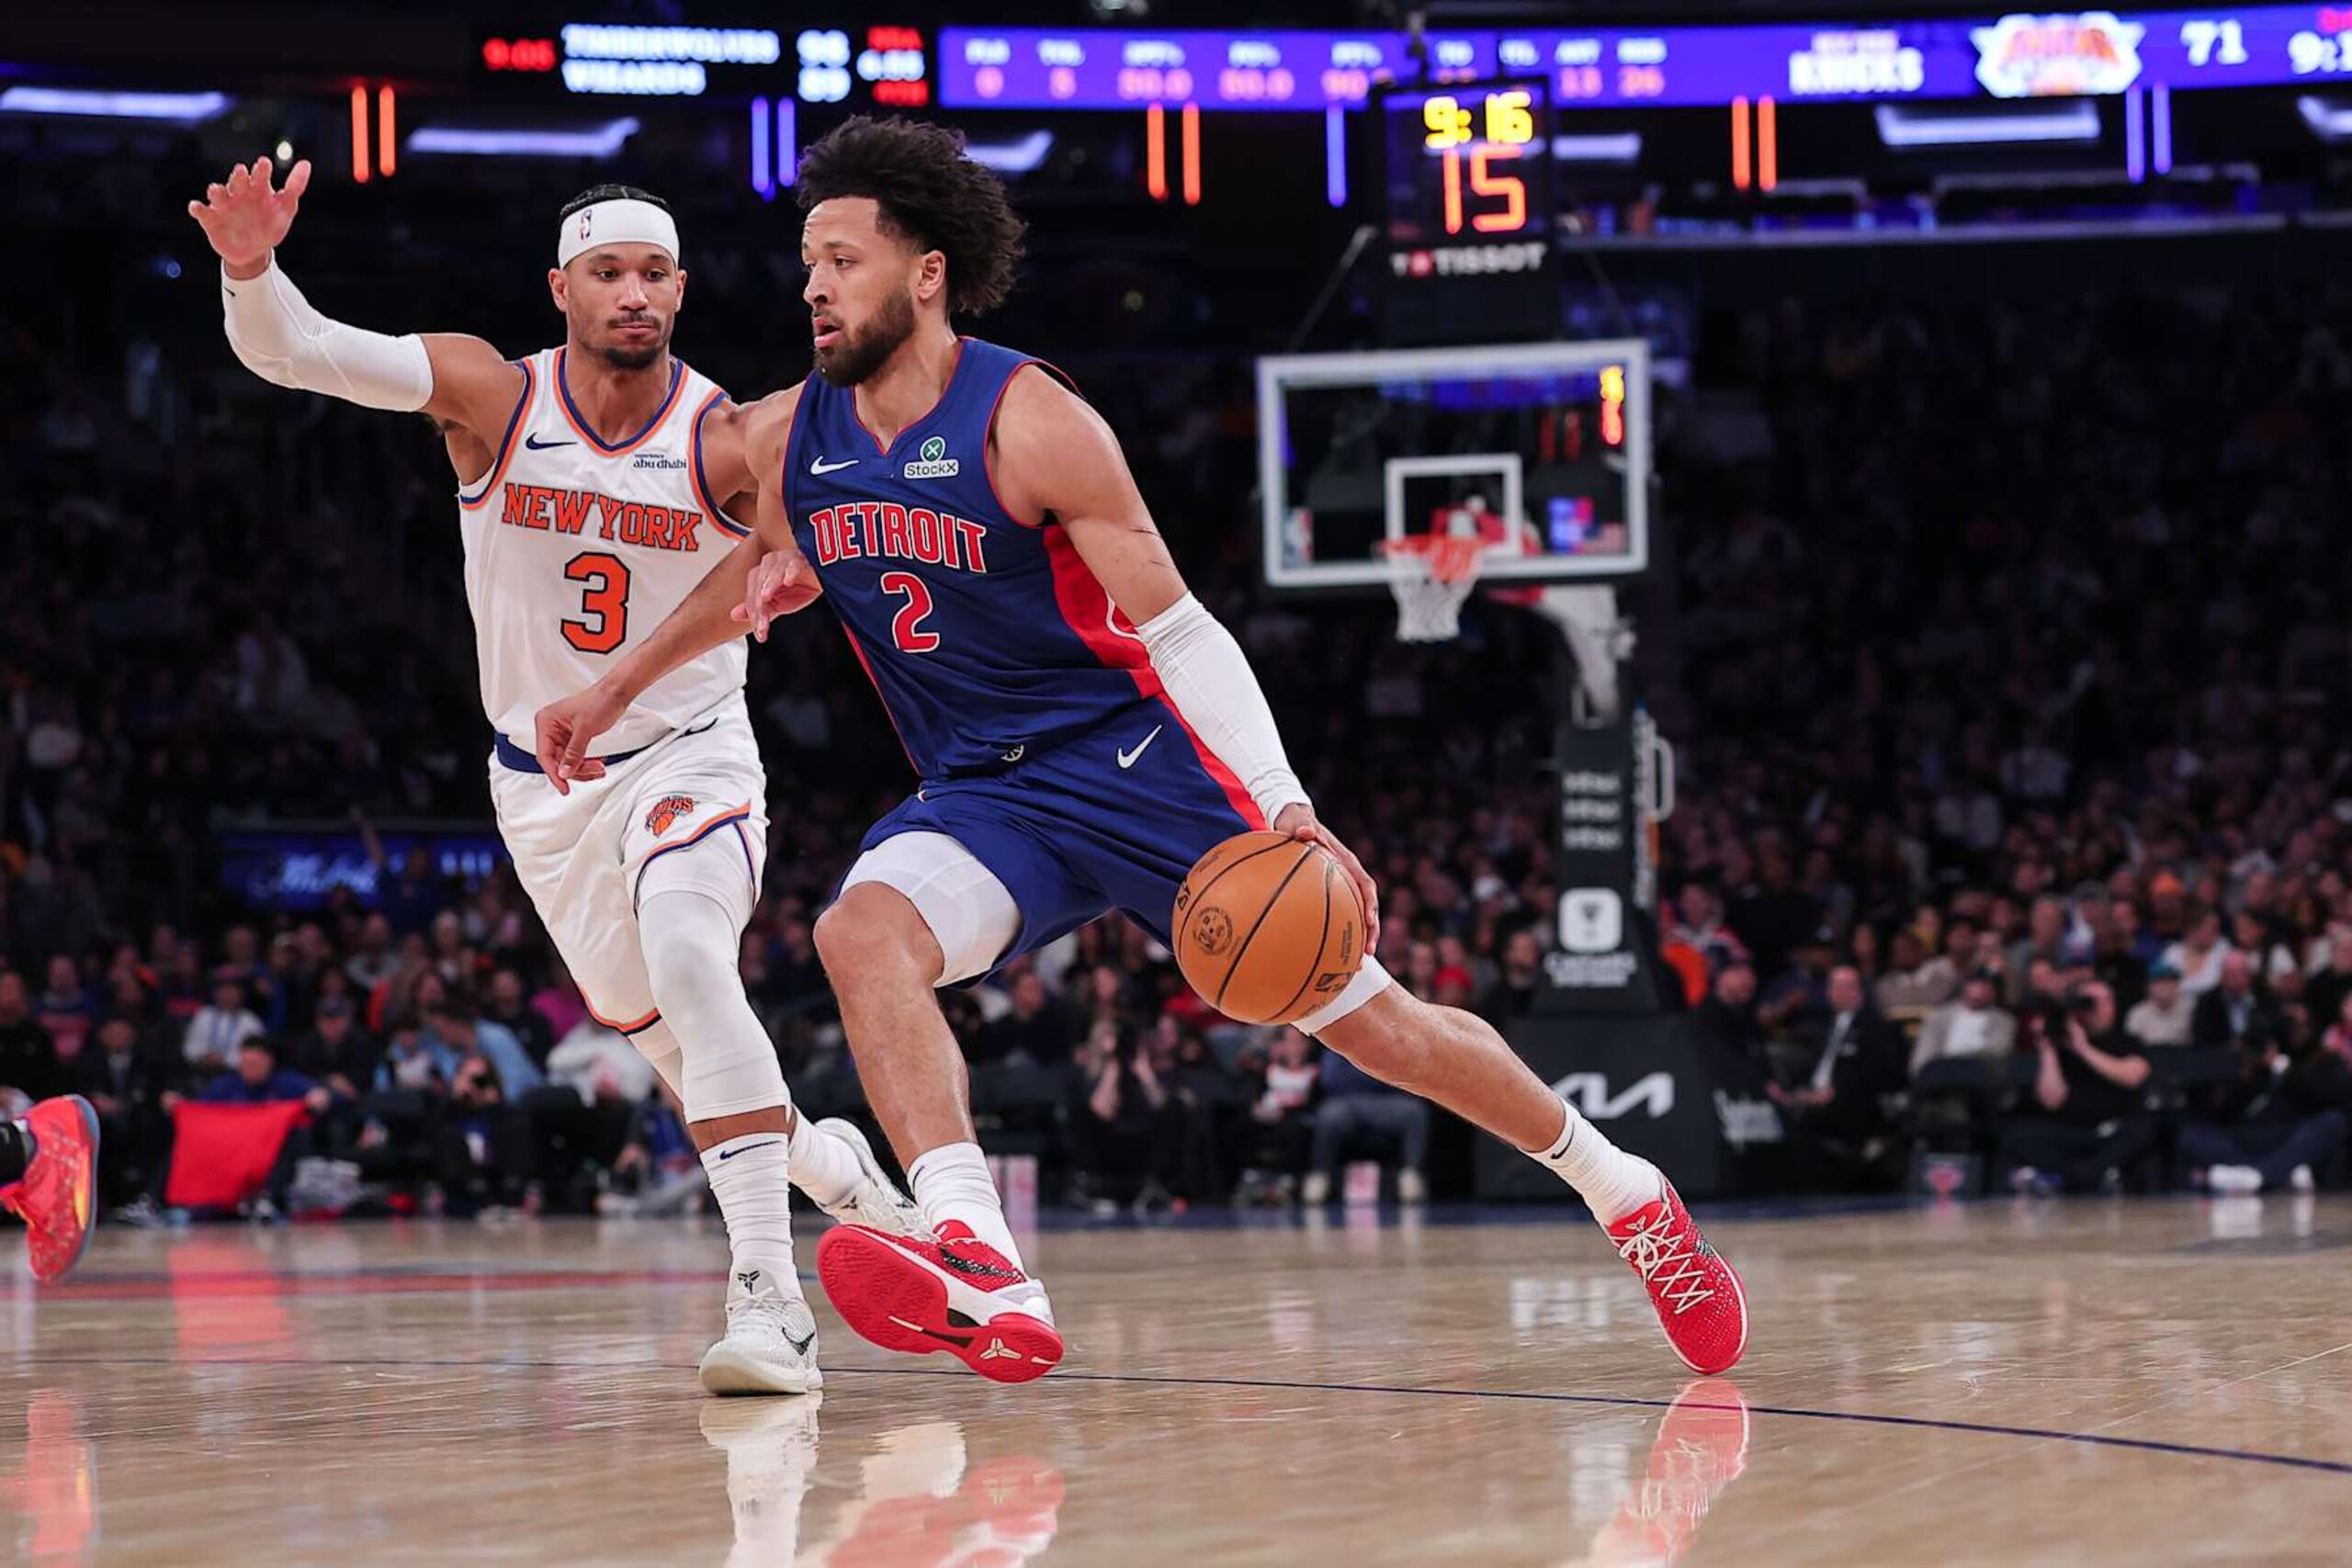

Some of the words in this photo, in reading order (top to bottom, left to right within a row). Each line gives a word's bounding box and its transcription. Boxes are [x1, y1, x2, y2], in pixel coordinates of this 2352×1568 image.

[2180, 19, 2249, 67] 71
[1424, 91, 1533, 149] 9:16
[1443, 144, 1526, 233] 15
[633, 458, 655, 468] abu
[657, 458, 687, 468] dhabi
[906, 461, 956, 476] StockX
[503, 483, 595, 536] NEW
[597, 494, 703, 551] YORK
[809, 502, 988, 573] DETROIT
[560, 551, 630, 654] 3
[880, 571, 940, 653] 2
